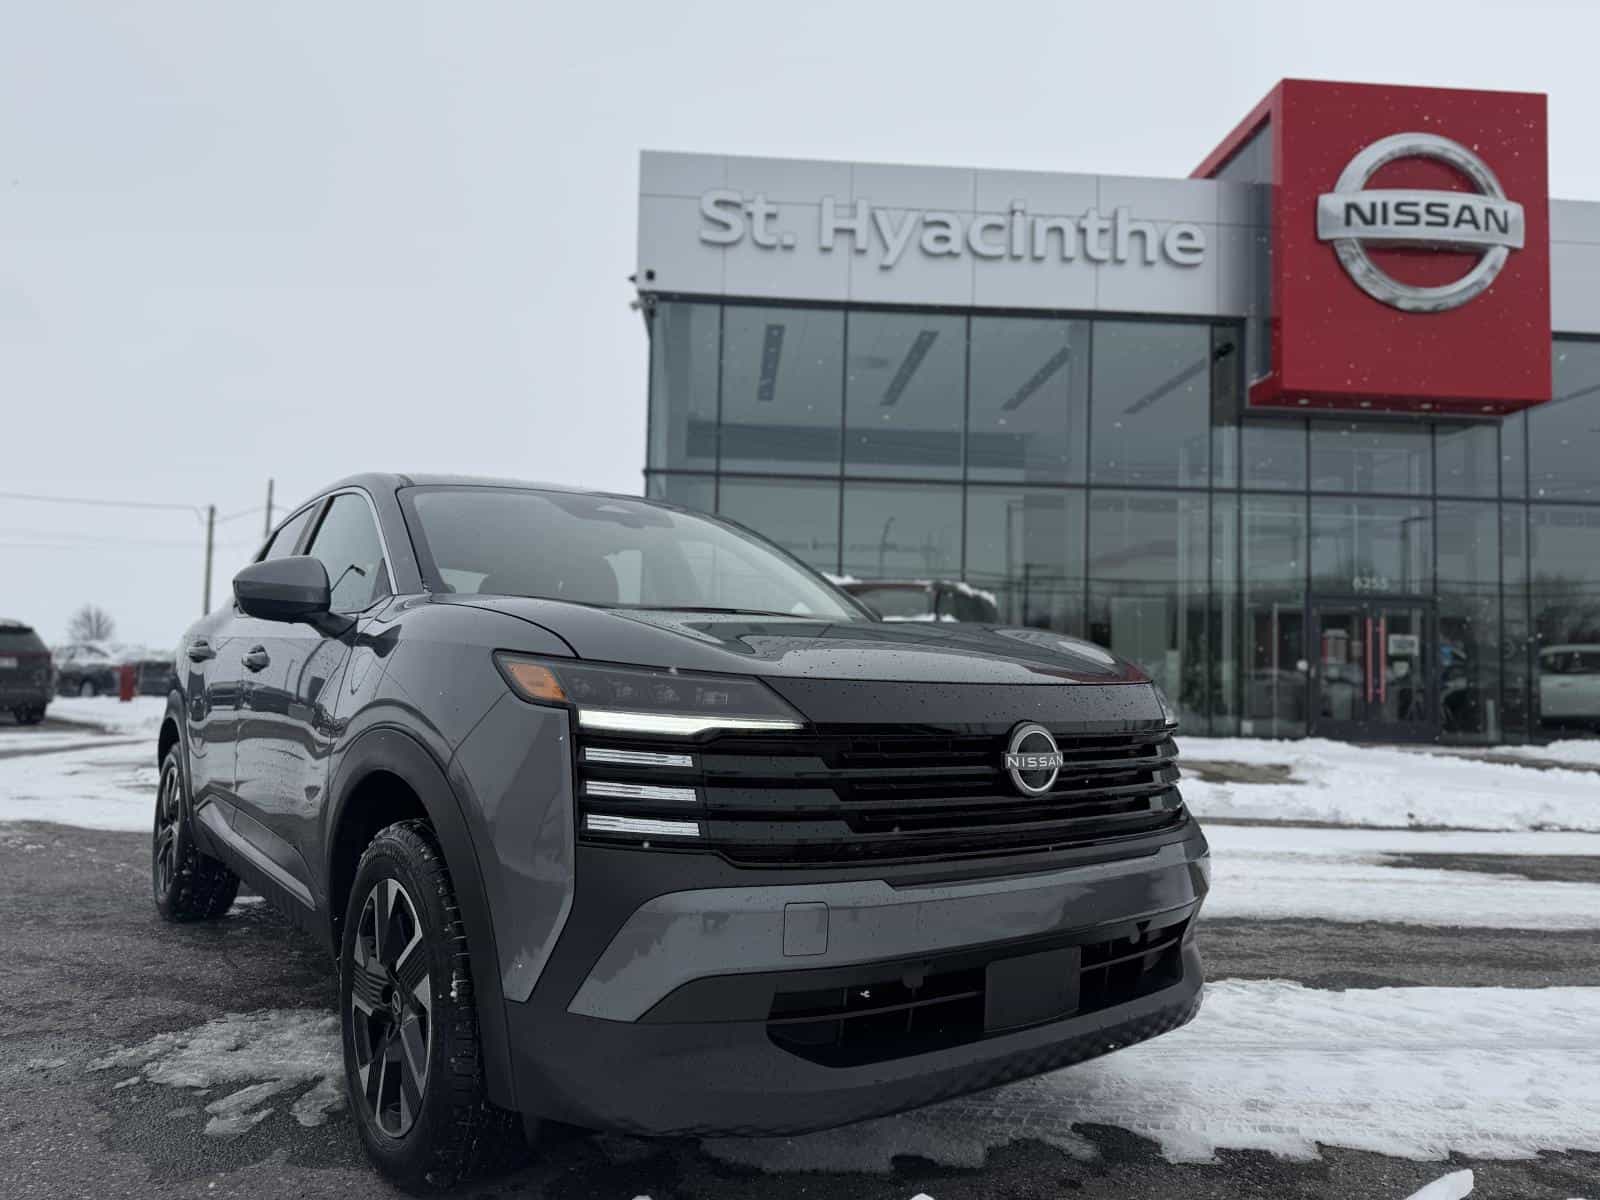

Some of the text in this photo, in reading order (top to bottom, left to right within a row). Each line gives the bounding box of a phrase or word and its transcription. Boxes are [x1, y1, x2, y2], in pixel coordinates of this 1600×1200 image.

[699, 188, 1207, 269] St. Hyacinthe
[1344, 201, 1509, 235] NISSAN
[1007, 754, 1063, 768] NISSAN
